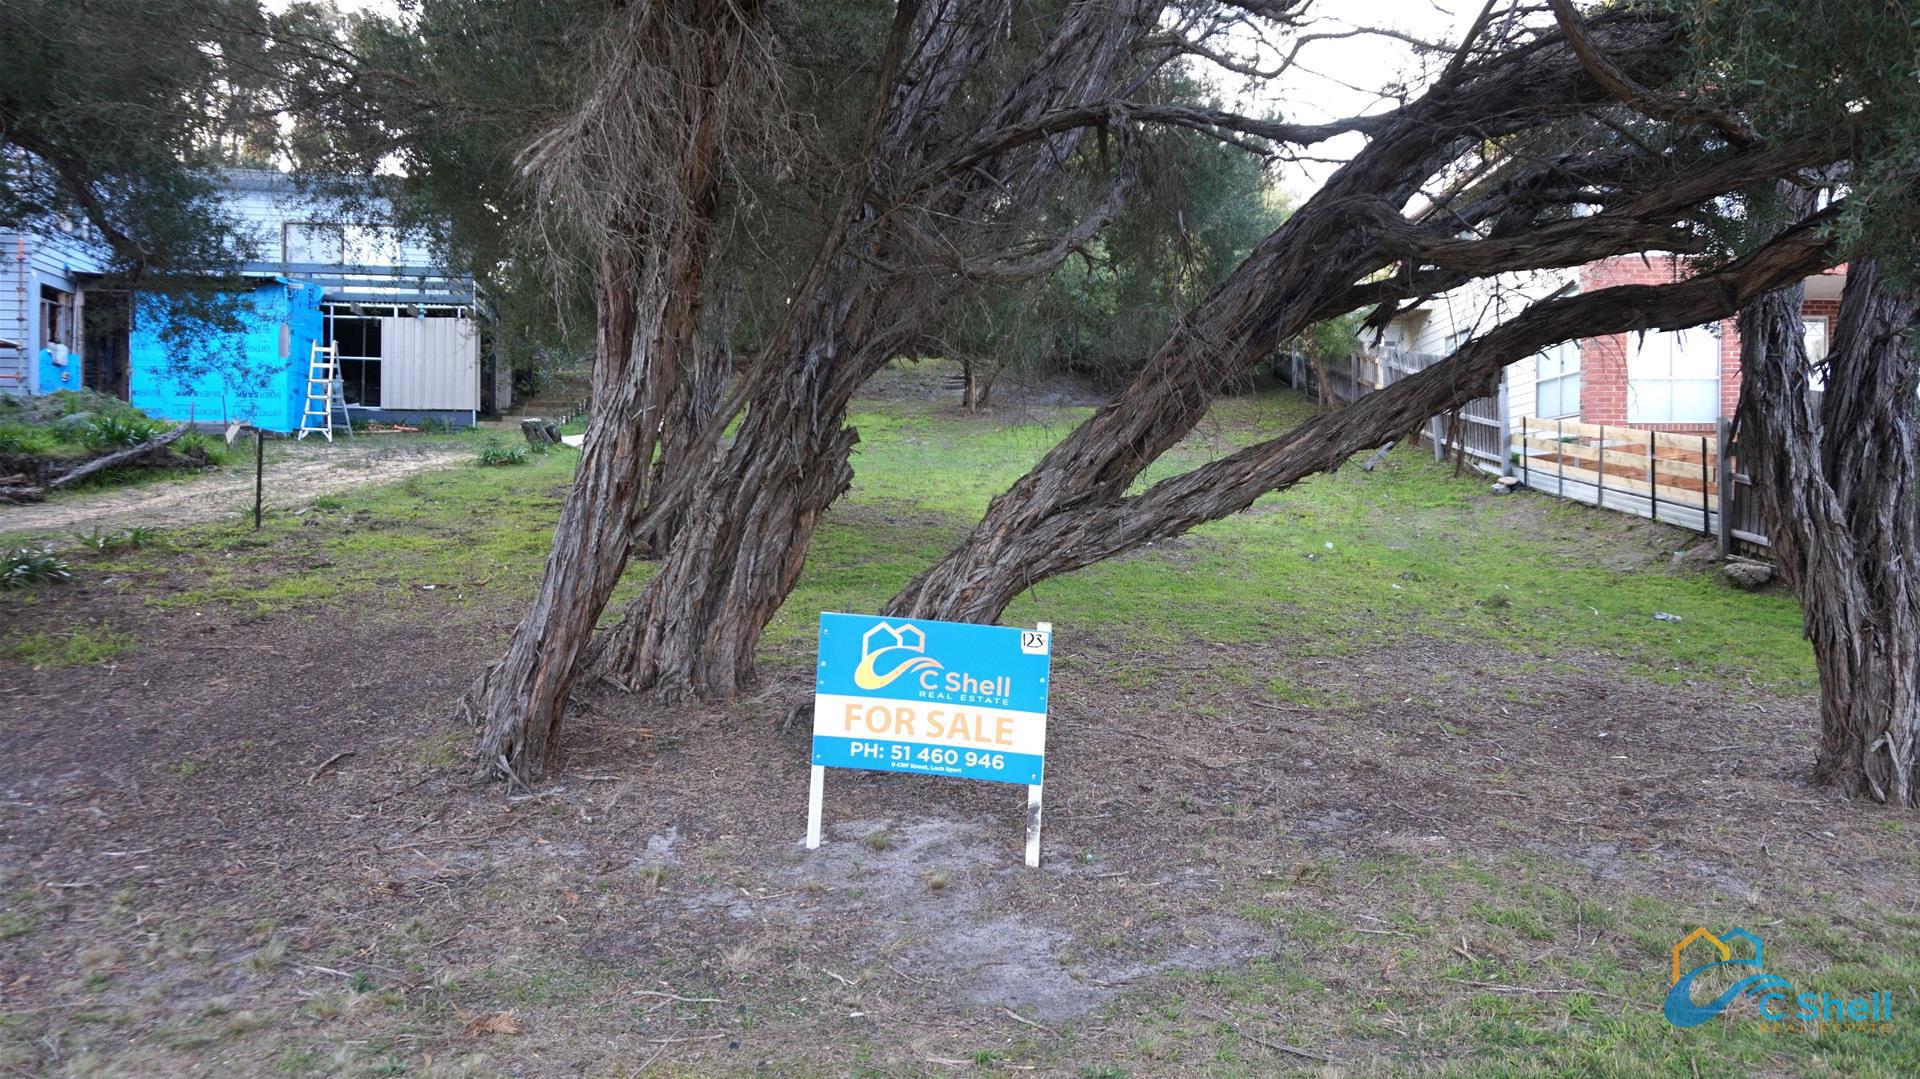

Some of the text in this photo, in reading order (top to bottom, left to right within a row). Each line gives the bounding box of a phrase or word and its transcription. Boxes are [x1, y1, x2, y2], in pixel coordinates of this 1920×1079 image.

[1022, 632, 1044, 648] 123
[919, 669, 1011, 697] C Shell
[919, 690, 1009, 706] REAL ESTATE
[844, 703, 1014, 746] FOR SALE
[850, 741, 1005, 770] PH: 51 460 946
